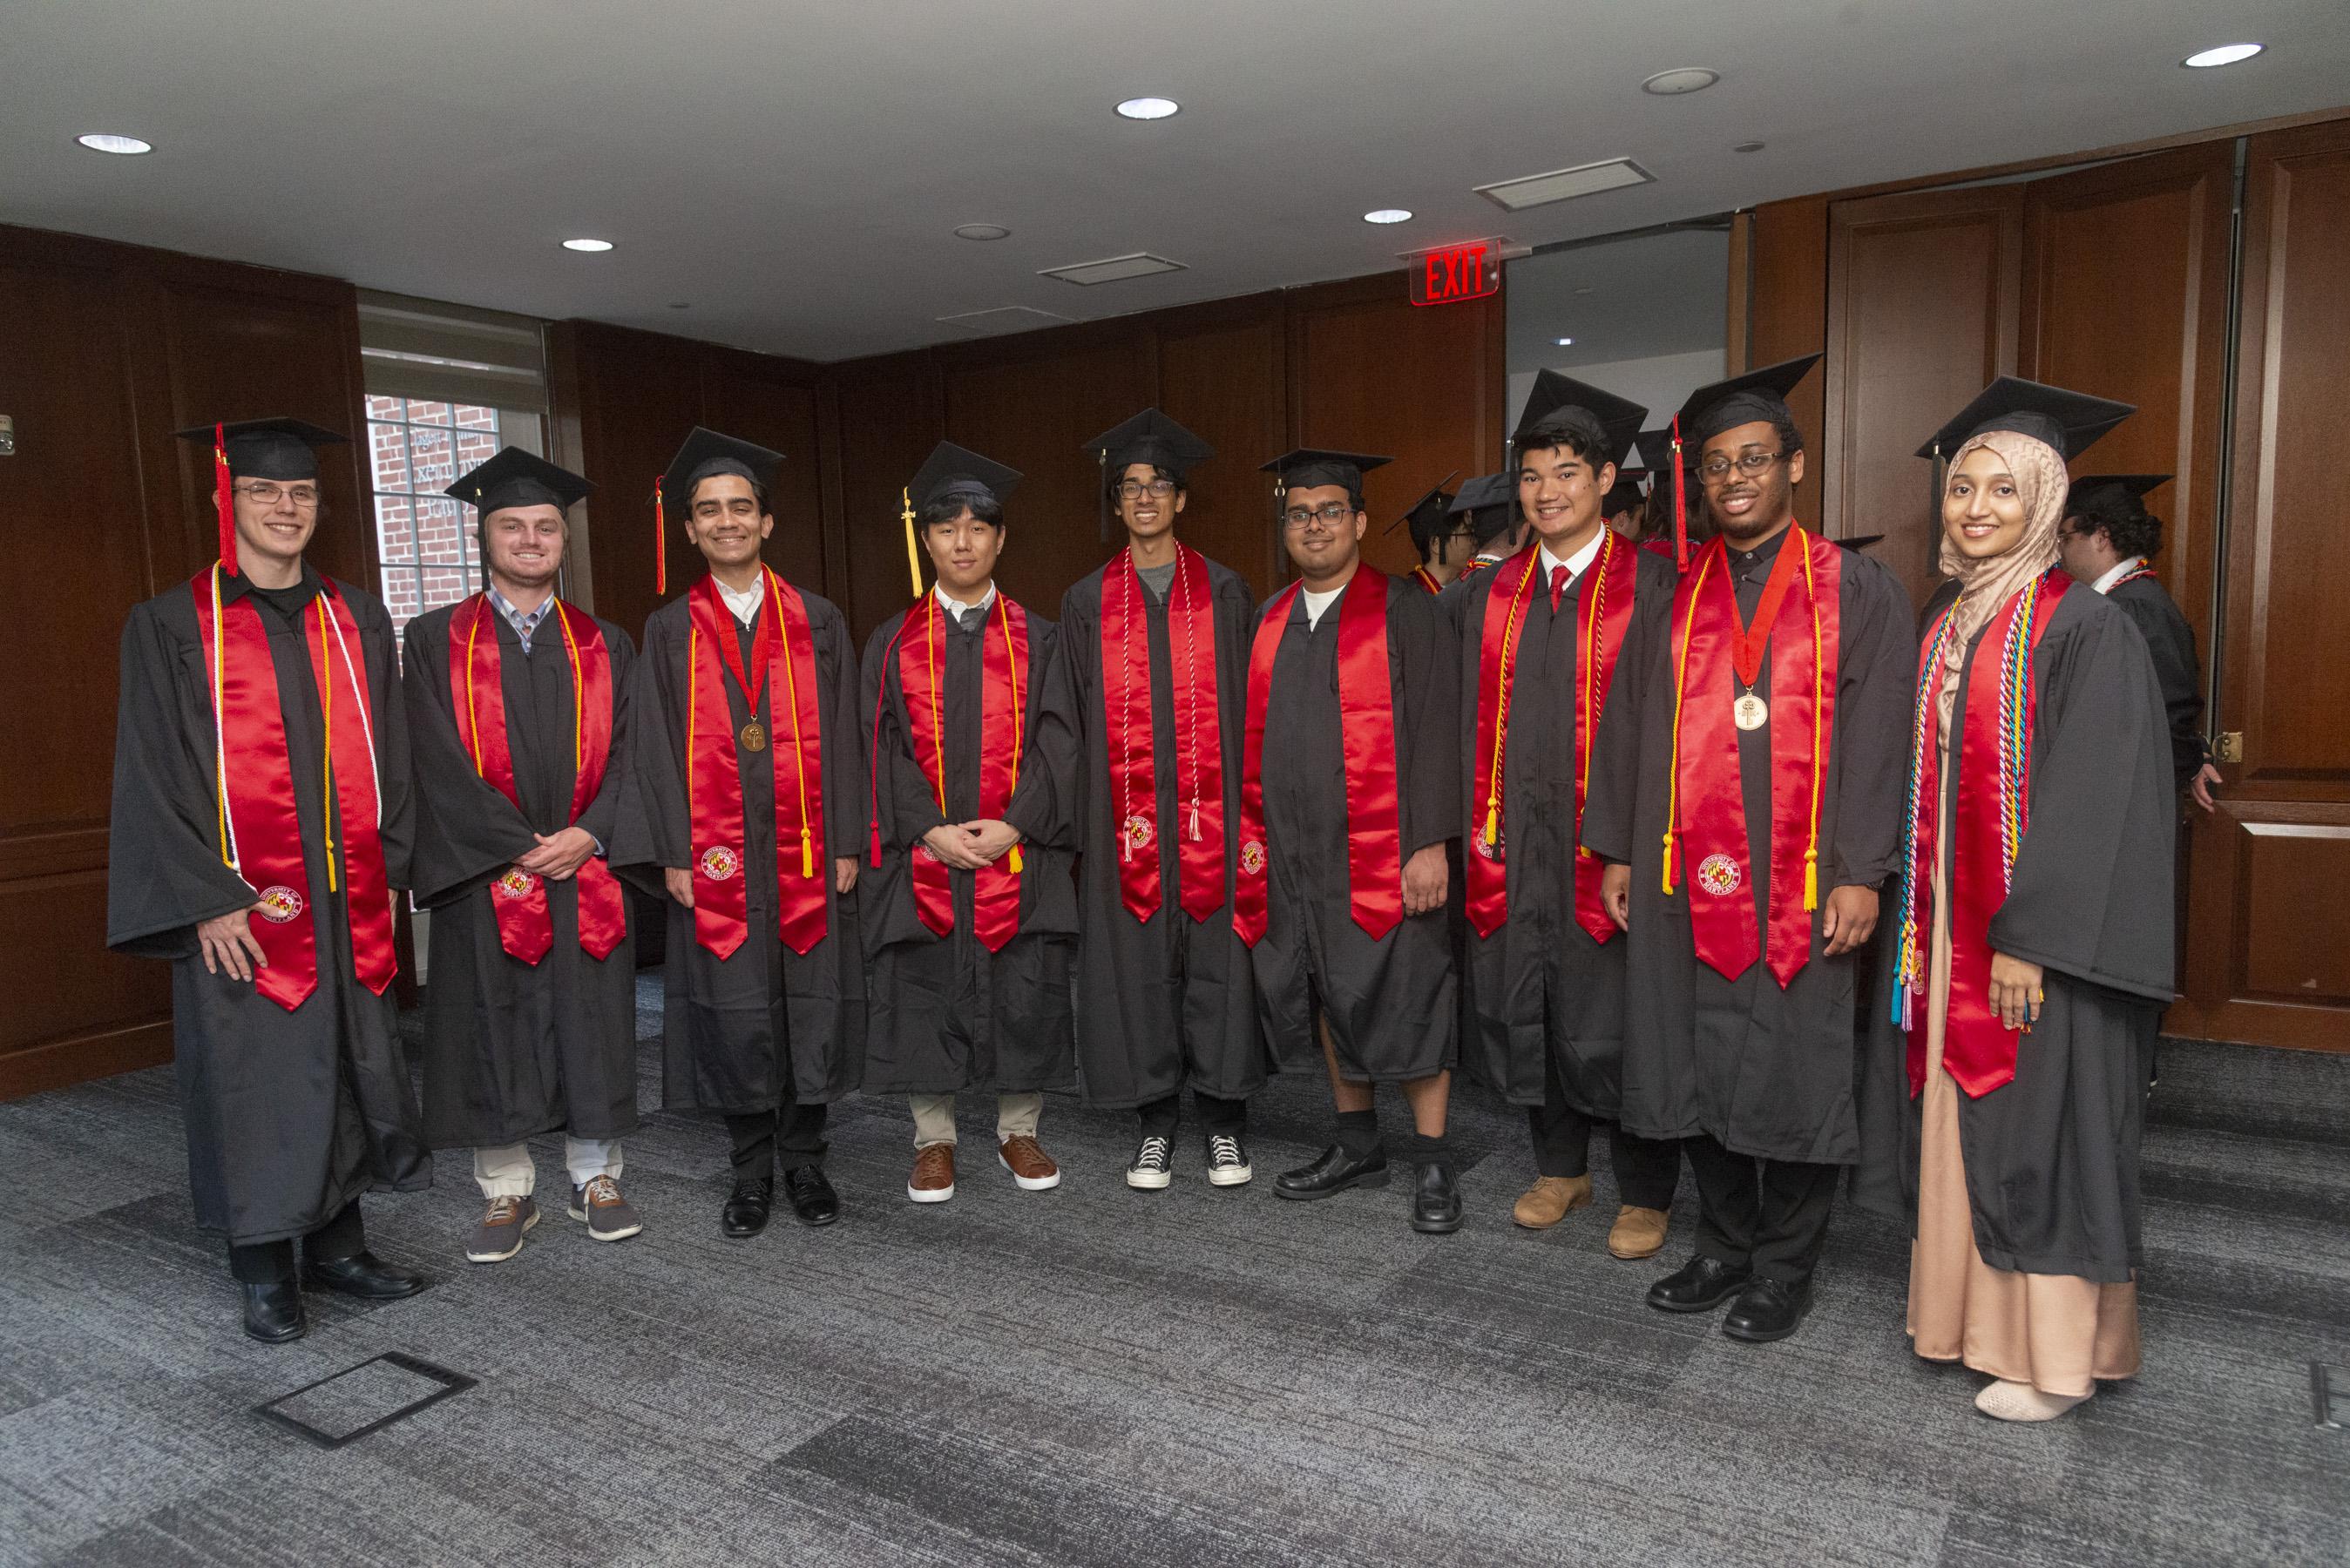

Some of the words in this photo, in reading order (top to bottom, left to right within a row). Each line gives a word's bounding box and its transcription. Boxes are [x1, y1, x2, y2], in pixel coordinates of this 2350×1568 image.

[1426, 247, 1487, 300] EXIT
[704, 847, 728, 859] UNIVERSITY
[1702, 856, 1730, 870] UNIVERSITY
[706, 868, 734, 879] MARYLAND
[1703, 880, 1737, 893] MARYLAND
[261, 887, 292, 900] UNIVERSITY
